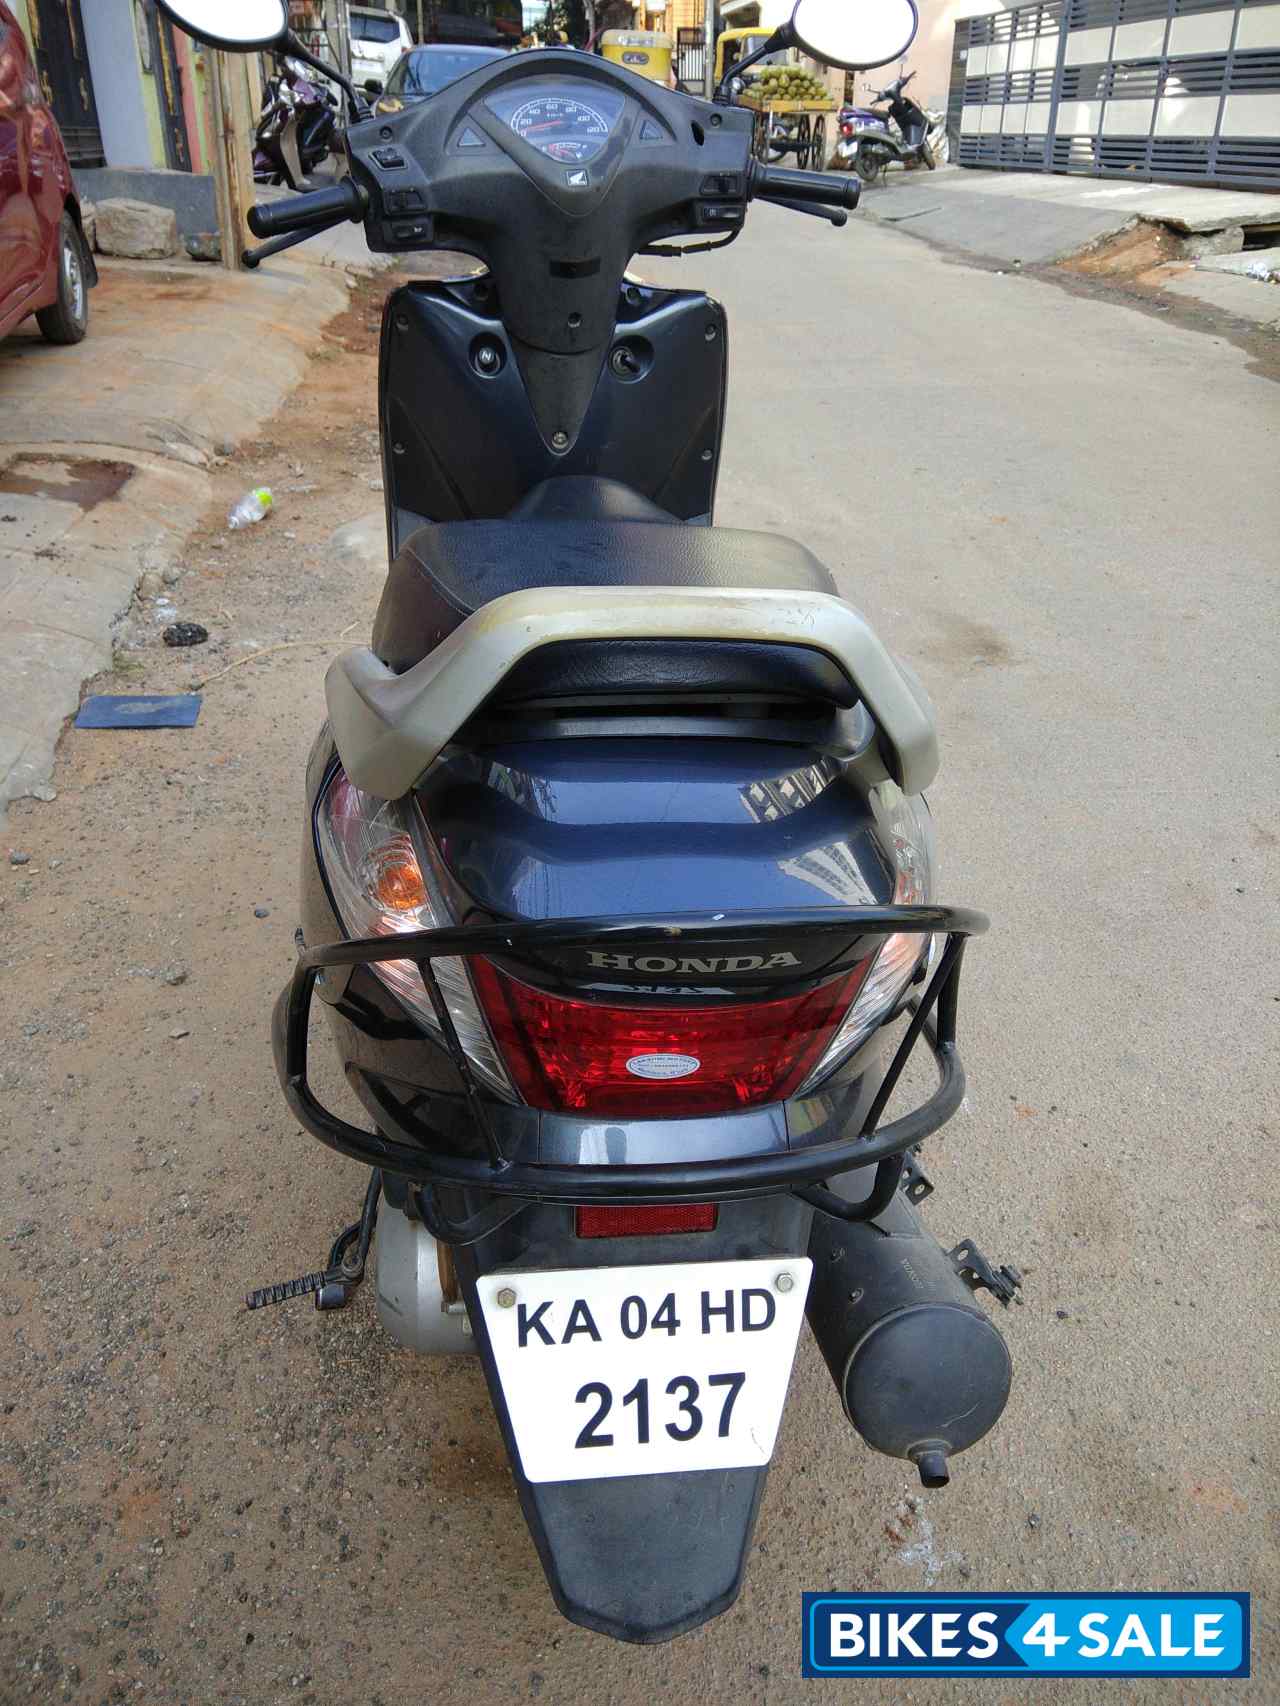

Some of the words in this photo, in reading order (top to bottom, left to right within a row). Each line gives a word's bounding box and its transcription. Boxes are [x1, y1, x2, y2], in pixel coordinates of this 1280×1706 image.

[586, 951, 801, 973] HONDA
[517, 1299, 602, 1348] KA
[620, 1293, 681, 1340] 04
[700, 1287, 777, 1333] HD
[574, 1371, 746, 1449] 2137
